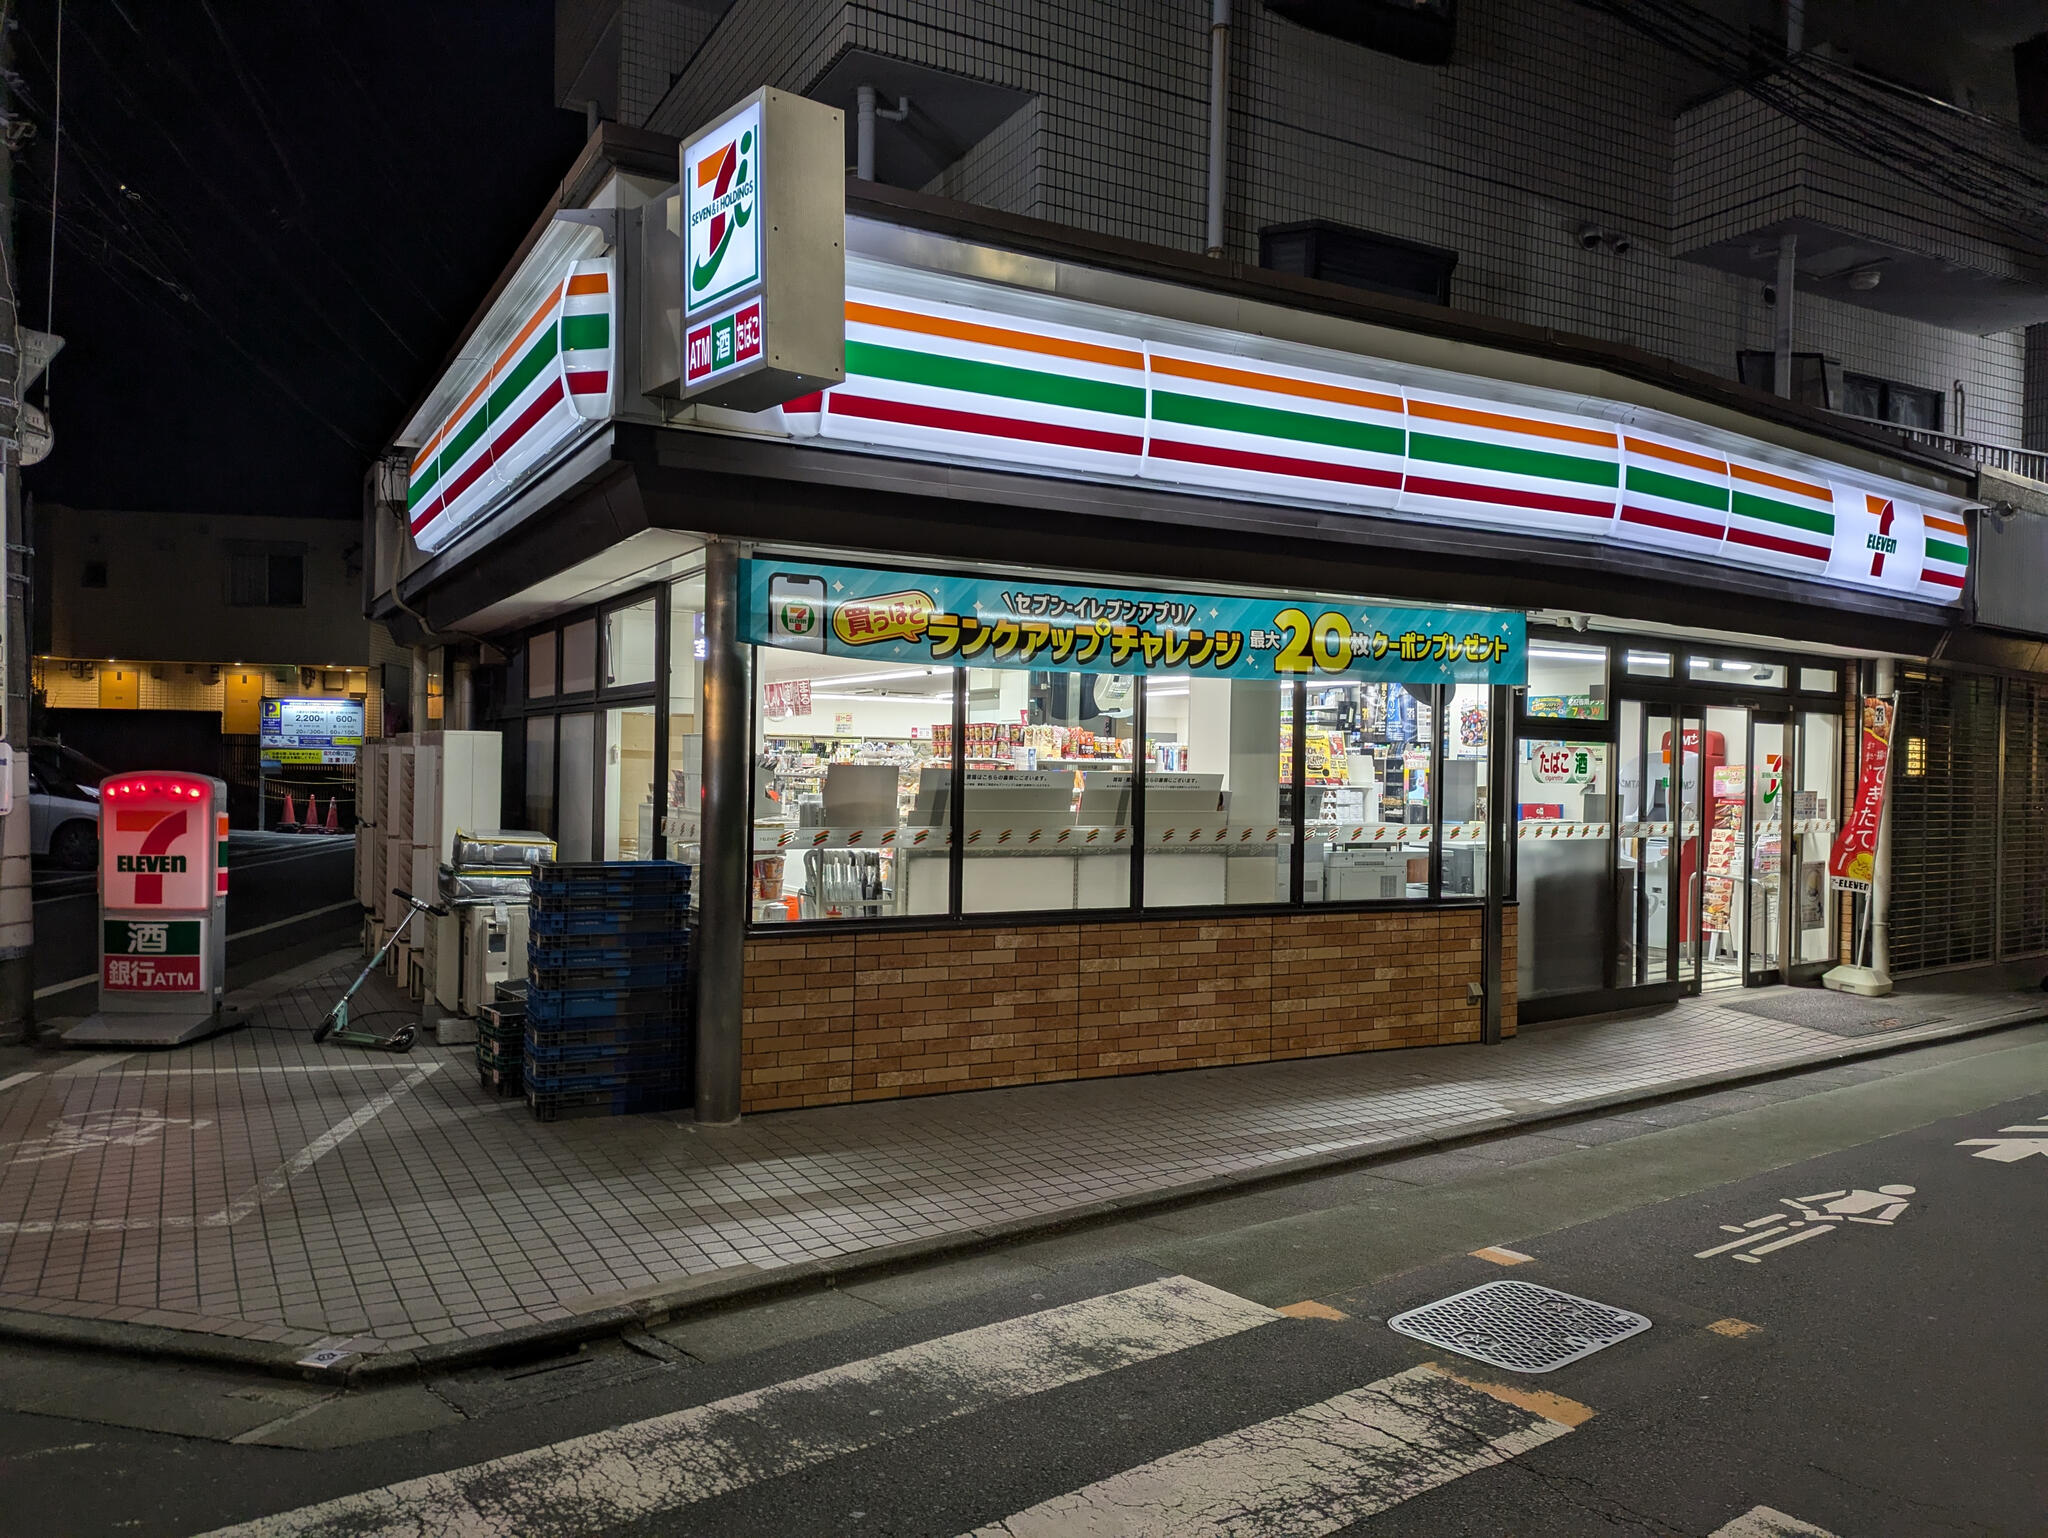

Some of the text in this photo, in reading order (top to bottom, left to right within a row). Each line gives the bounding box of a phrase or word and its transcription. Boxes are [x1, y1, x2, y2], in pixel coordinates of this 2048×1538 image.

[720, 180, 754, 211] HOLDINGS
[716, 325, 731, 360] 酒
[736, 313, 760, 353] たばこ
[689, 334, 710, 371] ATM
[844, 600, 925, 638] 買うほど
[927, 613, 1243, 668] ランクアップチャレンジ
[1539, 752, 1570, 774] たばこ
[1574, 752, 1589, 775] 酒
[127, 922, 169, 954] 酒
